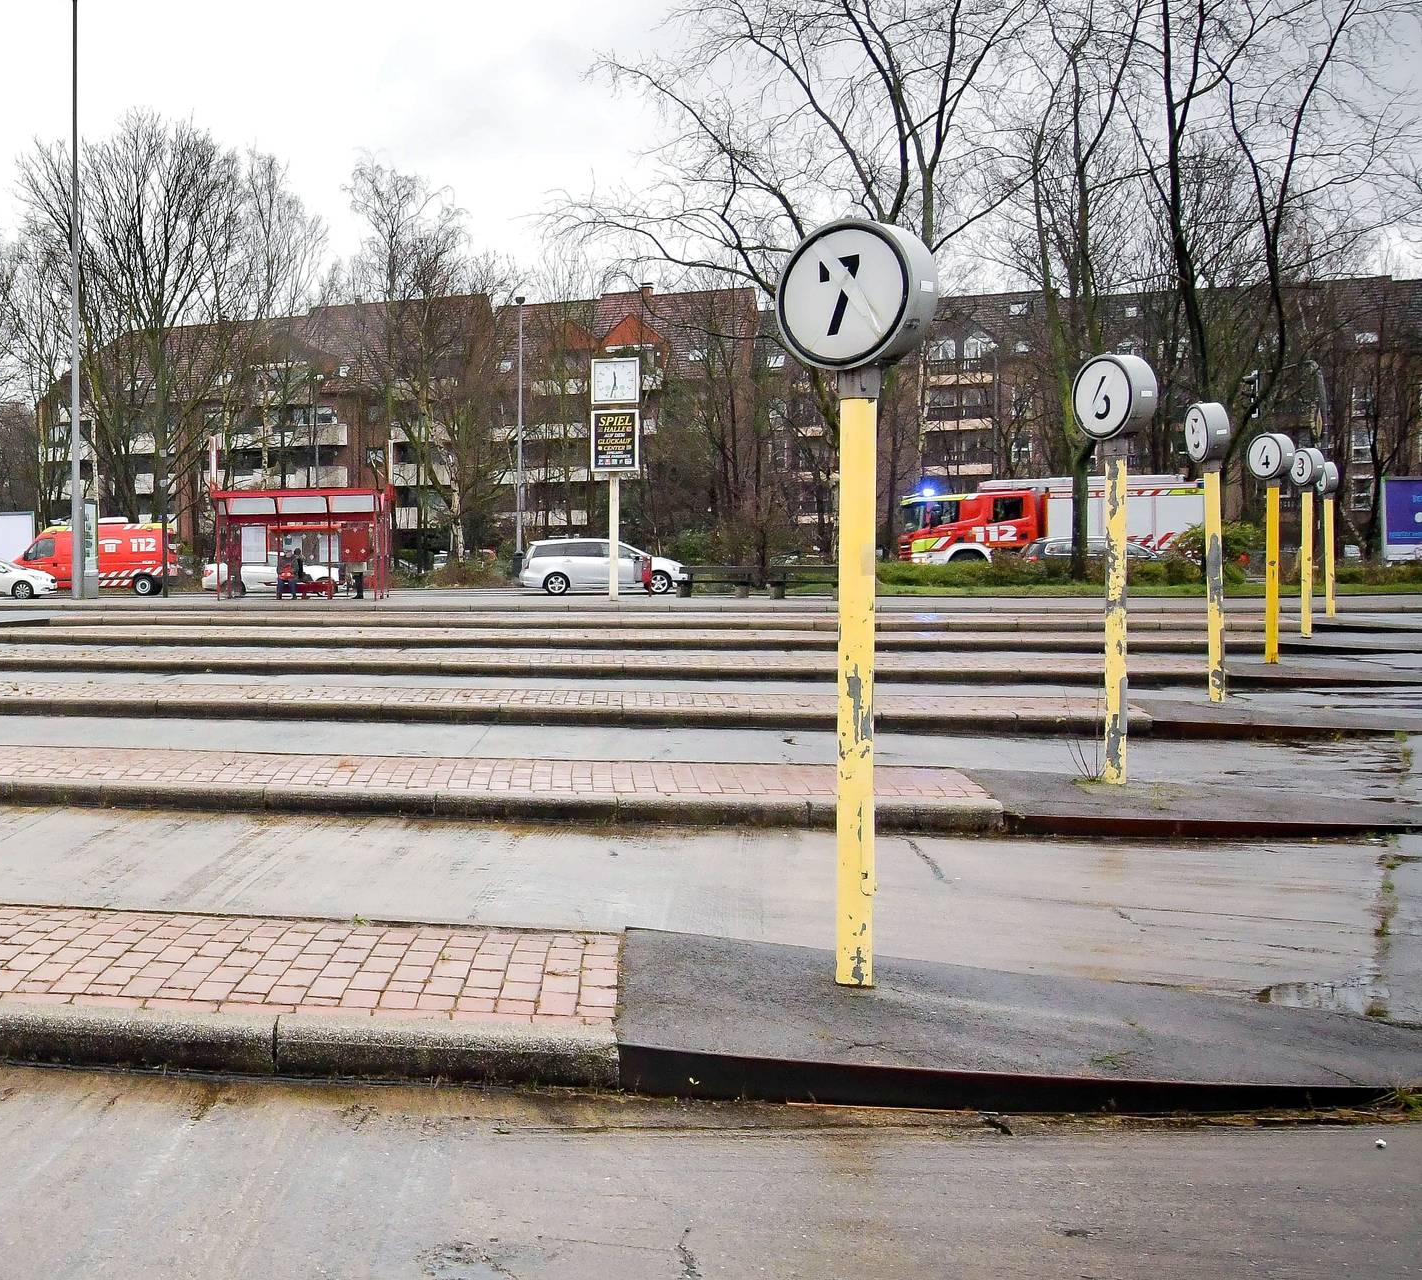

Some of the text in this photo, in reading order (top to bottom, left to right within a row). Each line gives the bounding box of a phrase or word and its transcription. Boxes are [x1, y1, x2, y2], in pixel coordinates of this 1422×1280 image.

[599, 415, 632, 426] SPIEL
[1297, 457, 1305, 477] 3
[971, 525, 1018, 542] 112
[129, 537, 157, 552] 112
